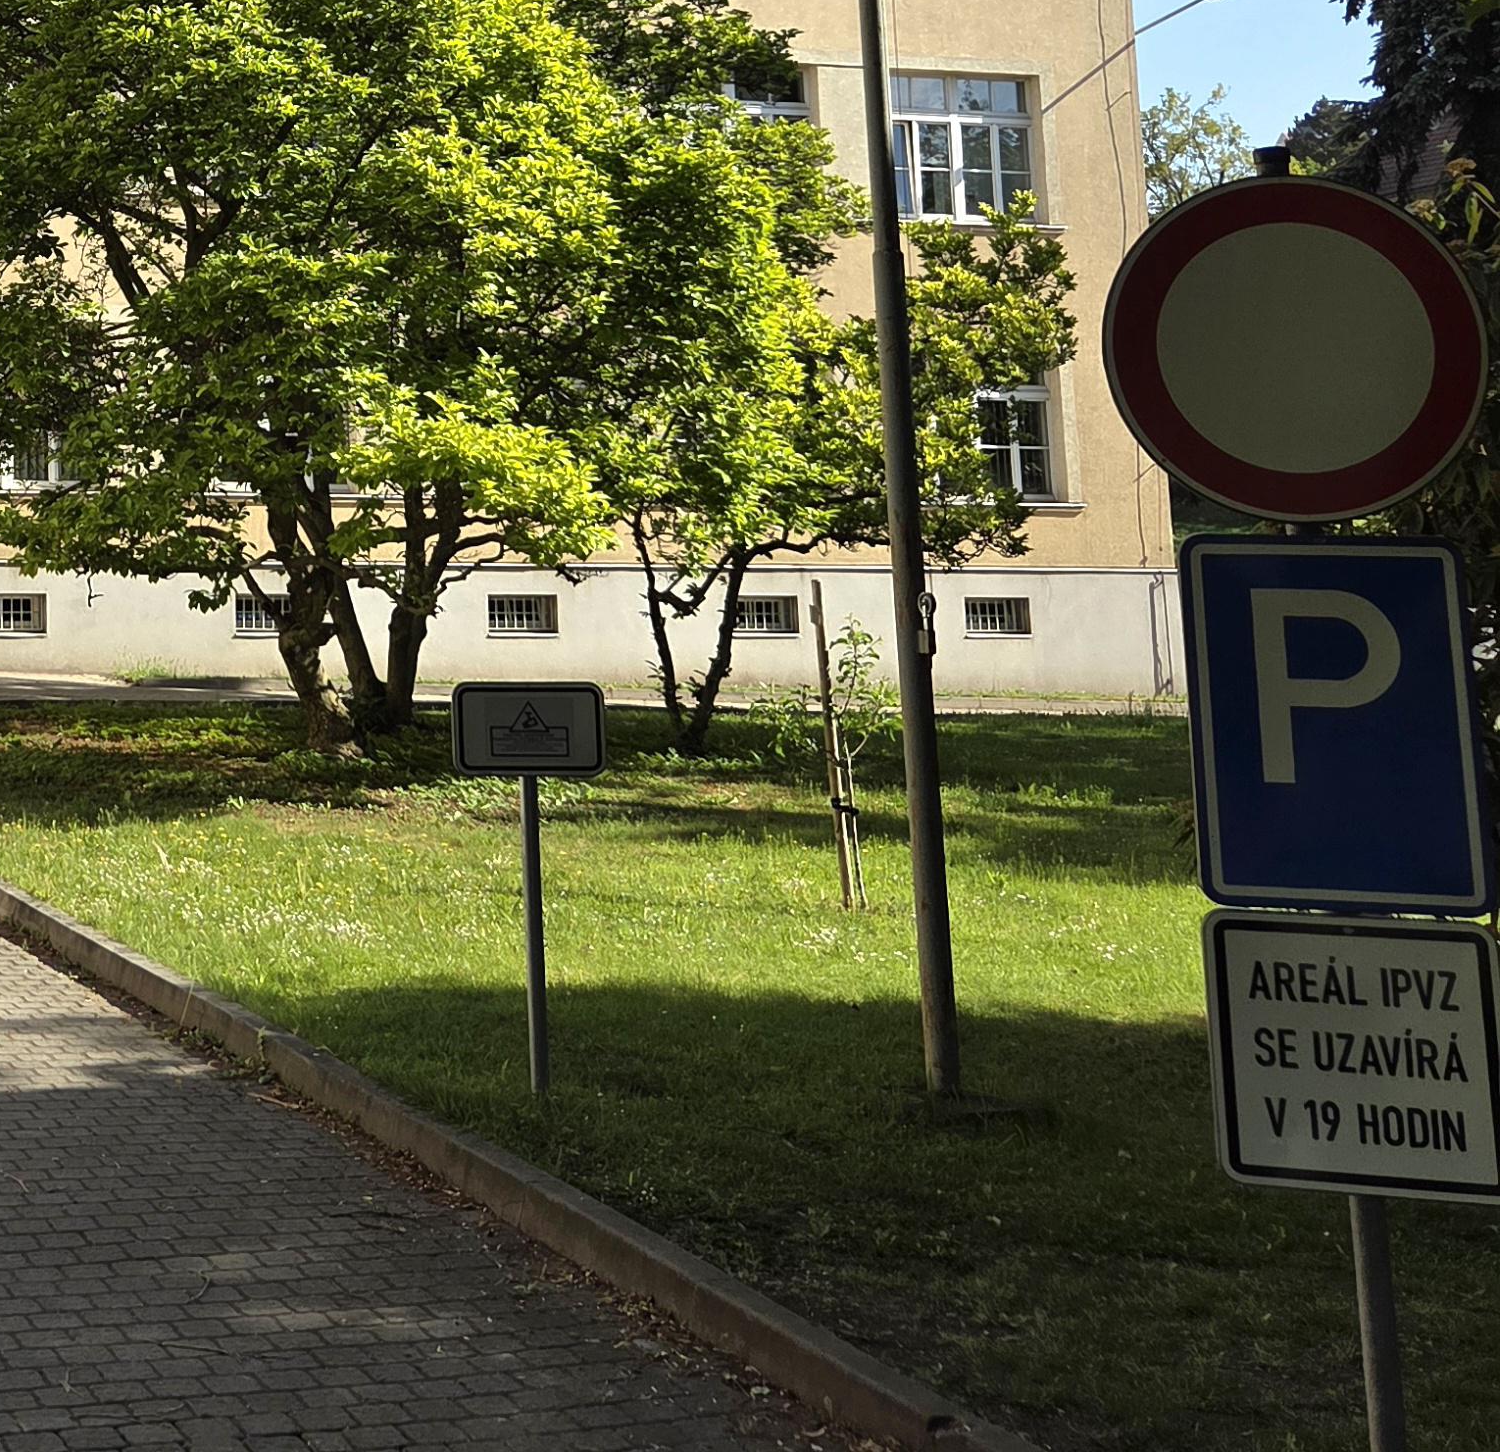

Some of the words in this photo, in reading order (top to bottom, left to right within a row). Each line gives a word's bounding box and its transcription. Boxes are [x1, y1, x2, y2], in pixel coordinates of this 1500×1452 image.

[1250, 588, 1401, 784] P
[1249, 956, 1368, 1006] AREÁL
[1380, 966, 1460, 1012] IPVZ
[1254, 1027, 1299, 1069] SE
[1312, 1028, 1469, 1083] UZAVÍRÁ
[1264, 1096, 1287, 1138] V
[1303, 1099, 1341, 1142] 19
[1357, 1103, 1467, 1153] HODIN
